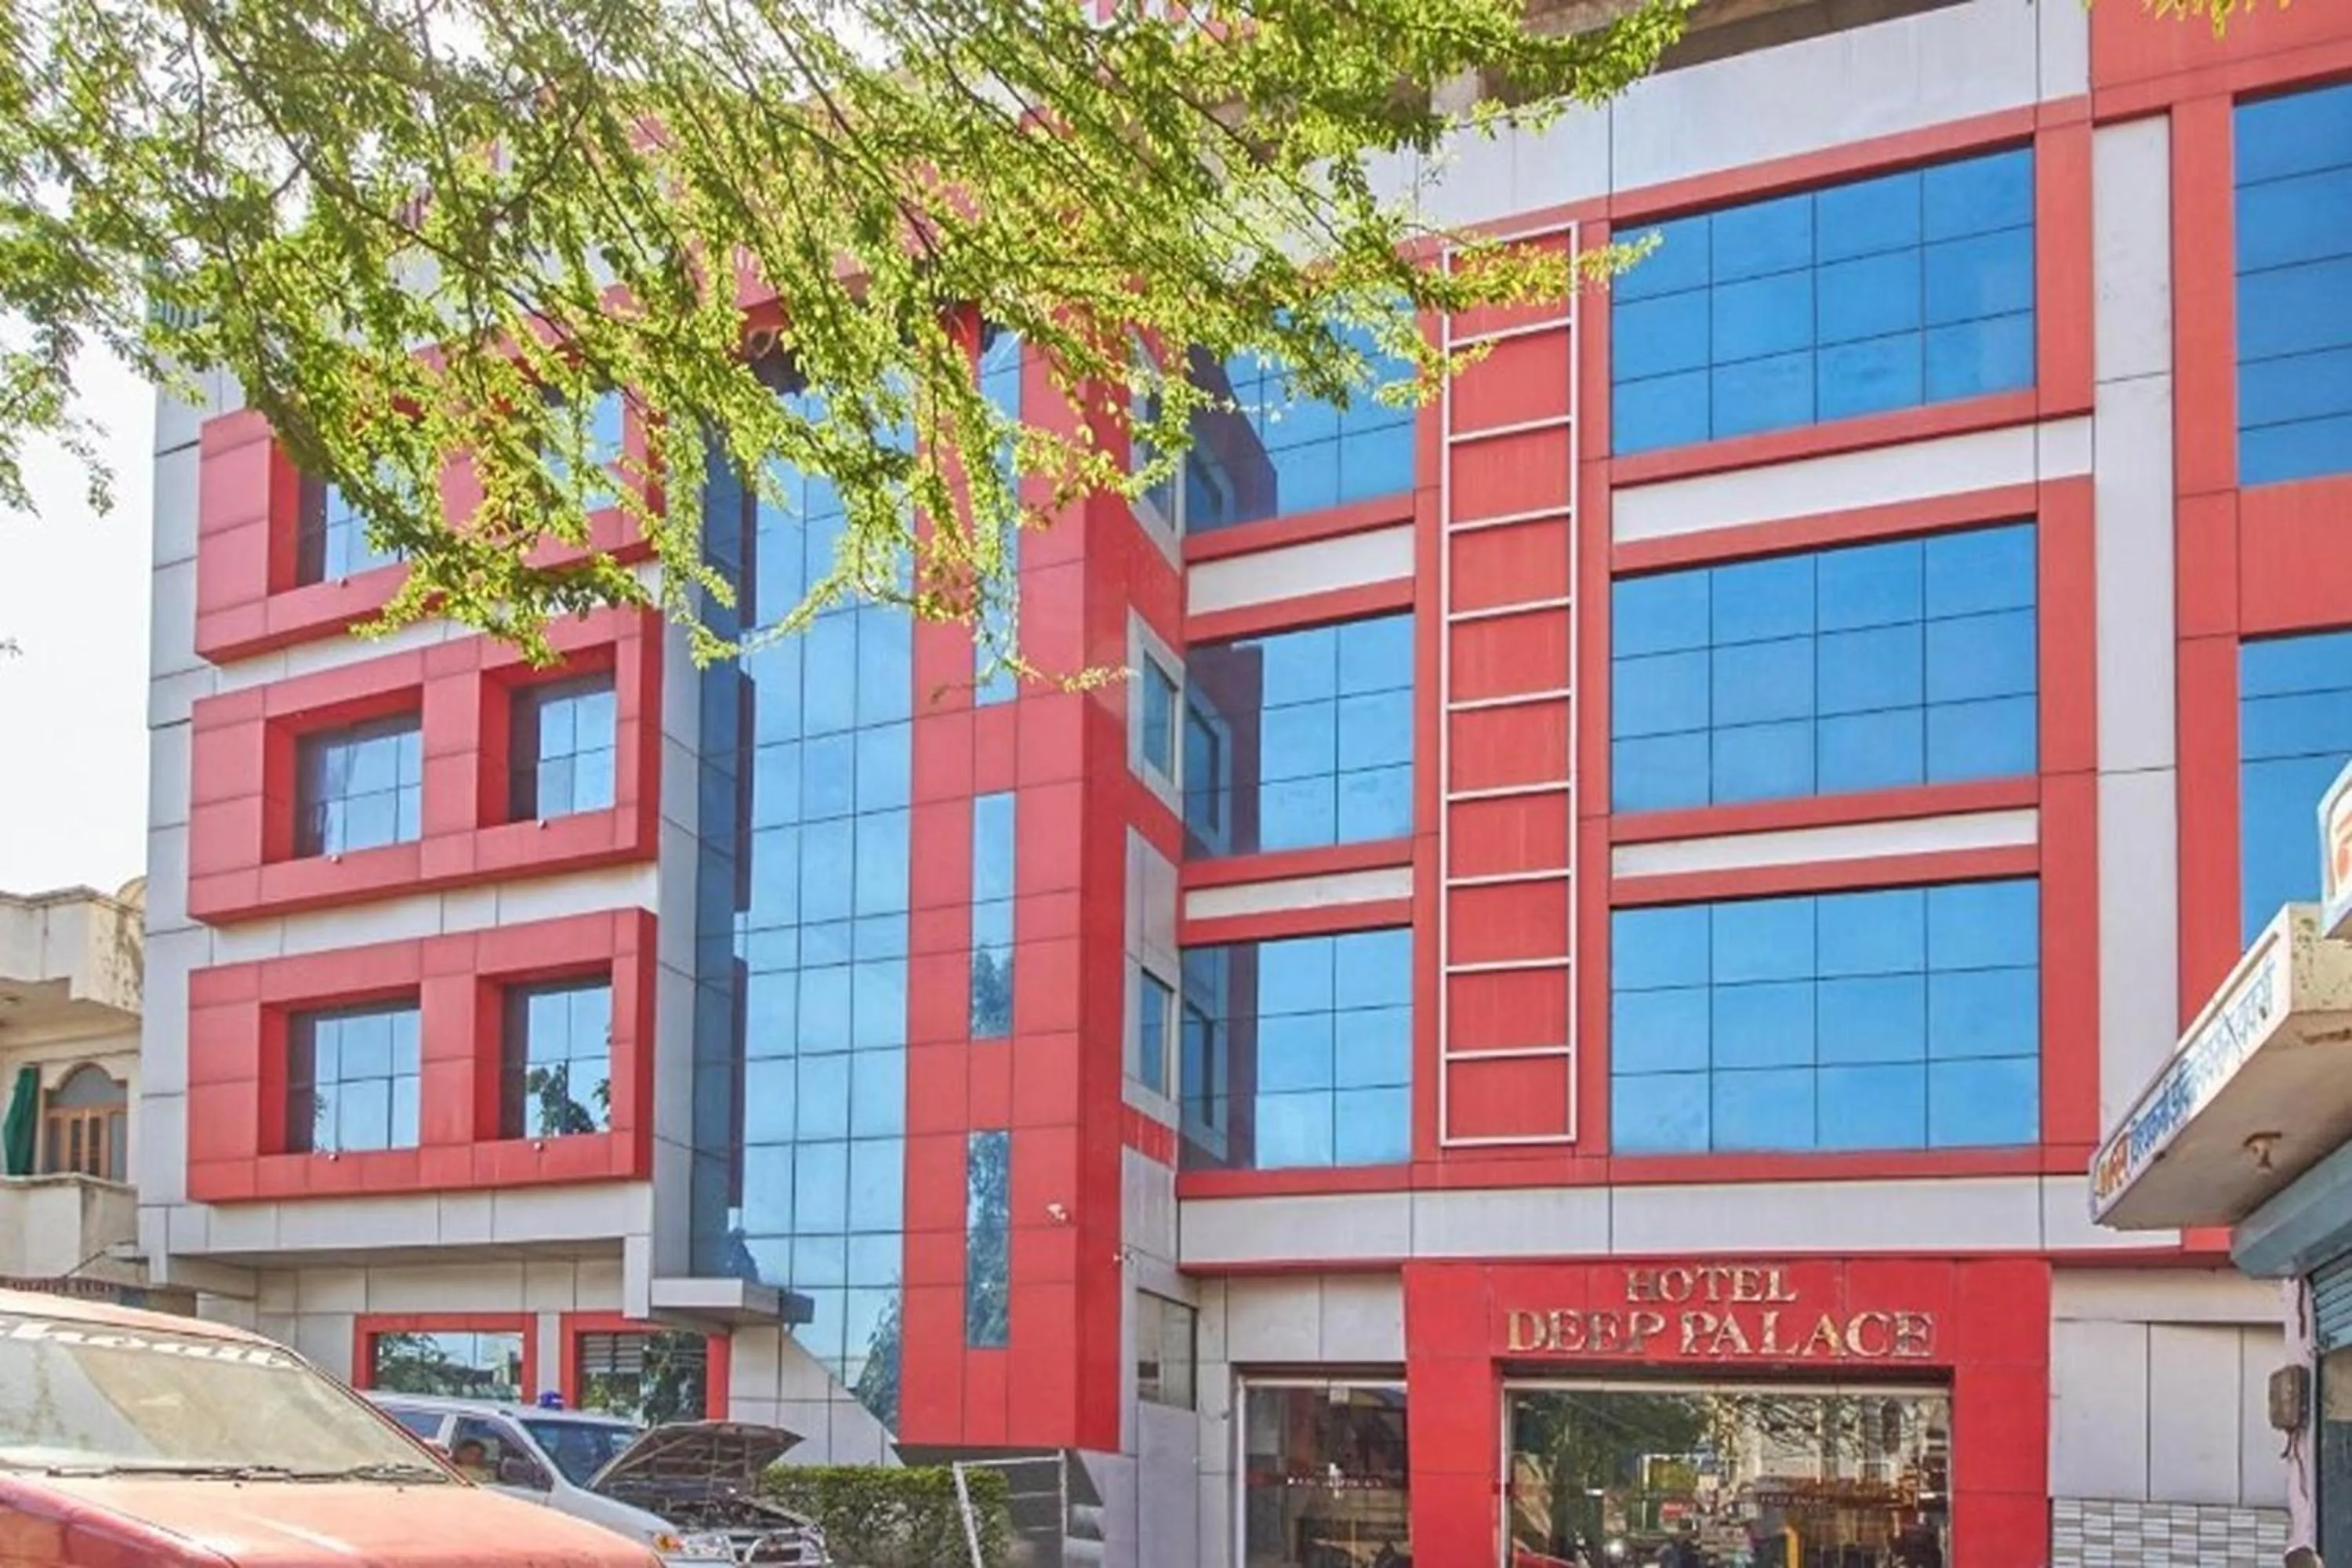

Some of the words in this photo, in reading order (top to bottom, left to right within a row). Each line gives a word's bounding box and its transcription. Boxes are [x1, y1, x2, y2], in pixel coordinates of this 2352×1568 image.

[1626, 1265, 1797, 1302] HOTEL
[1507, 1308, 1666, 1354] DEEP
[1680, 1310, 1934, 1357] PALACE
